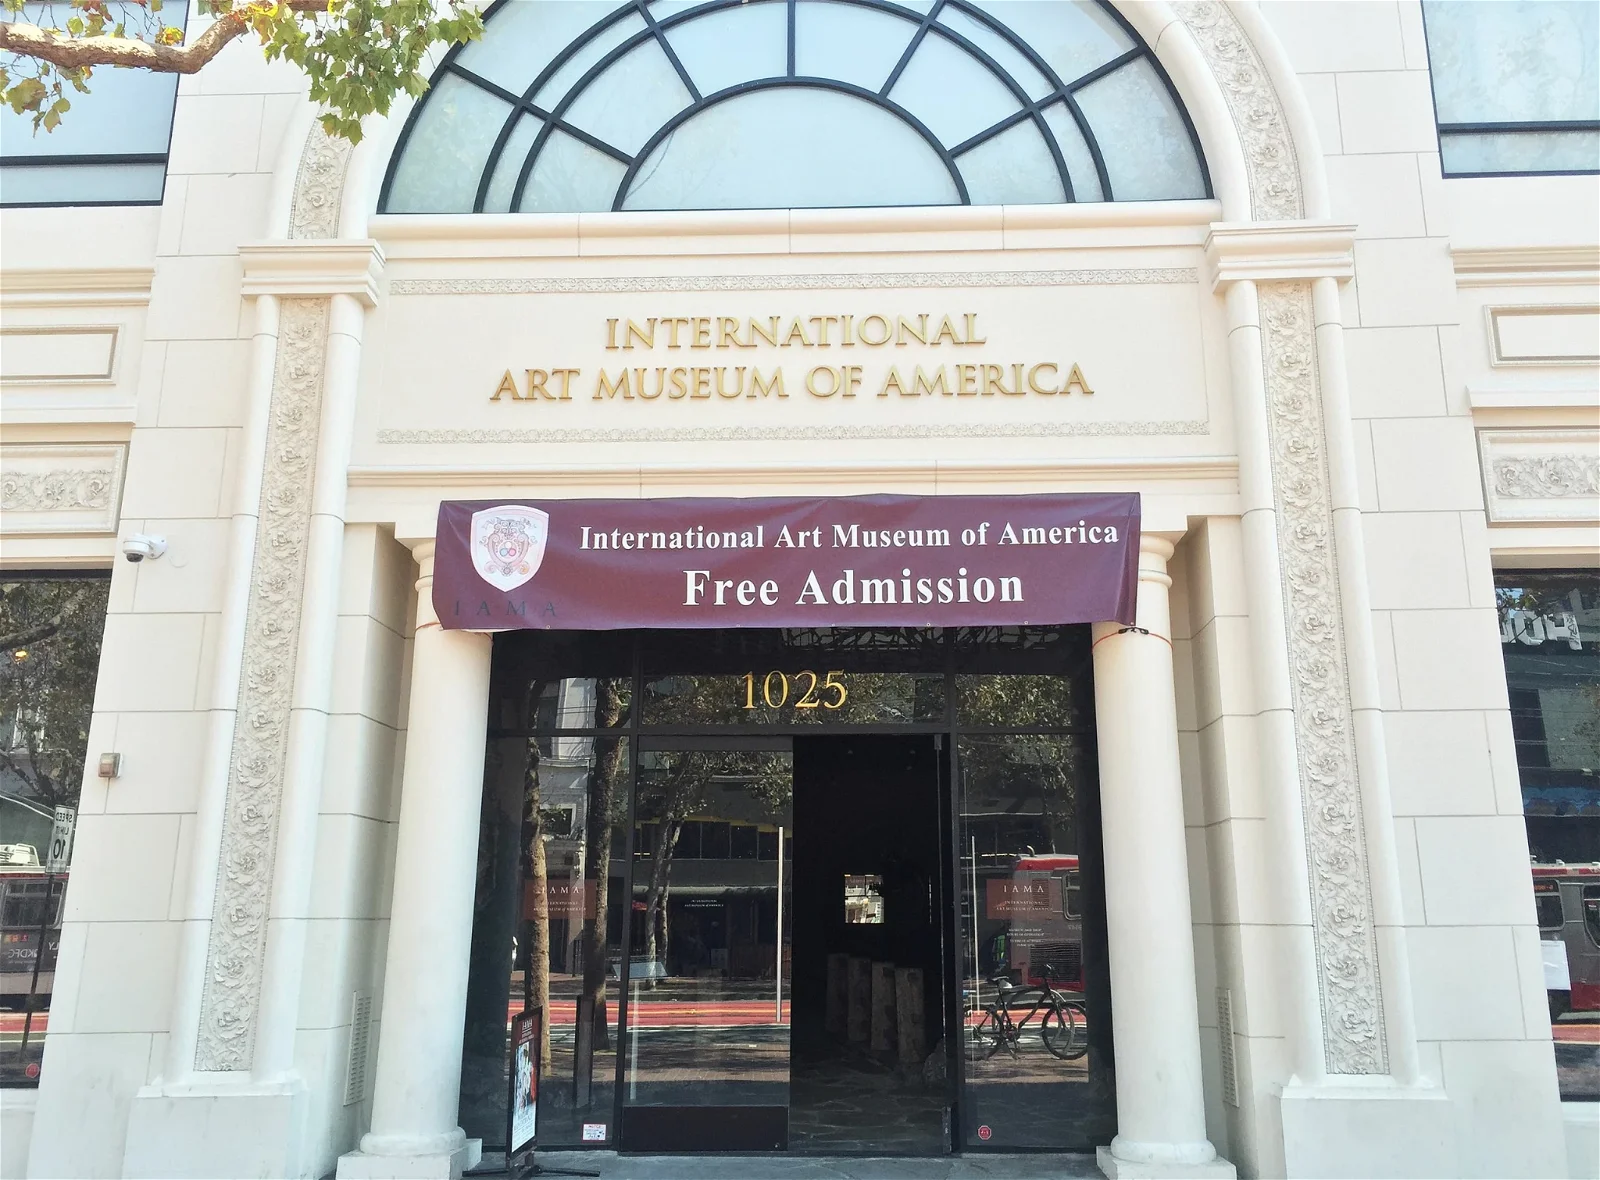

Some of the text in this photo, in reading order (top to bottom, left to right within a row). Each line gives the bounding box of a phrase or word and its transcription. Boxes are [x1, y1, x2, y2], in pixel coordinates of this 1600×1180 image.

[605, 313, 988, 350] INTERNATIONAL
[490, 362, 1095, 401] ART MUSEUM OF AMERICA
[580, 519, 1120, 550] International Art Museum of America
[683, 567, 1025, 606] Free Admission
[742, 670, 848, 711] 1025
[542, 886, 580, 894] IAMA
[1003, 885, 1045, 893] IAMA
